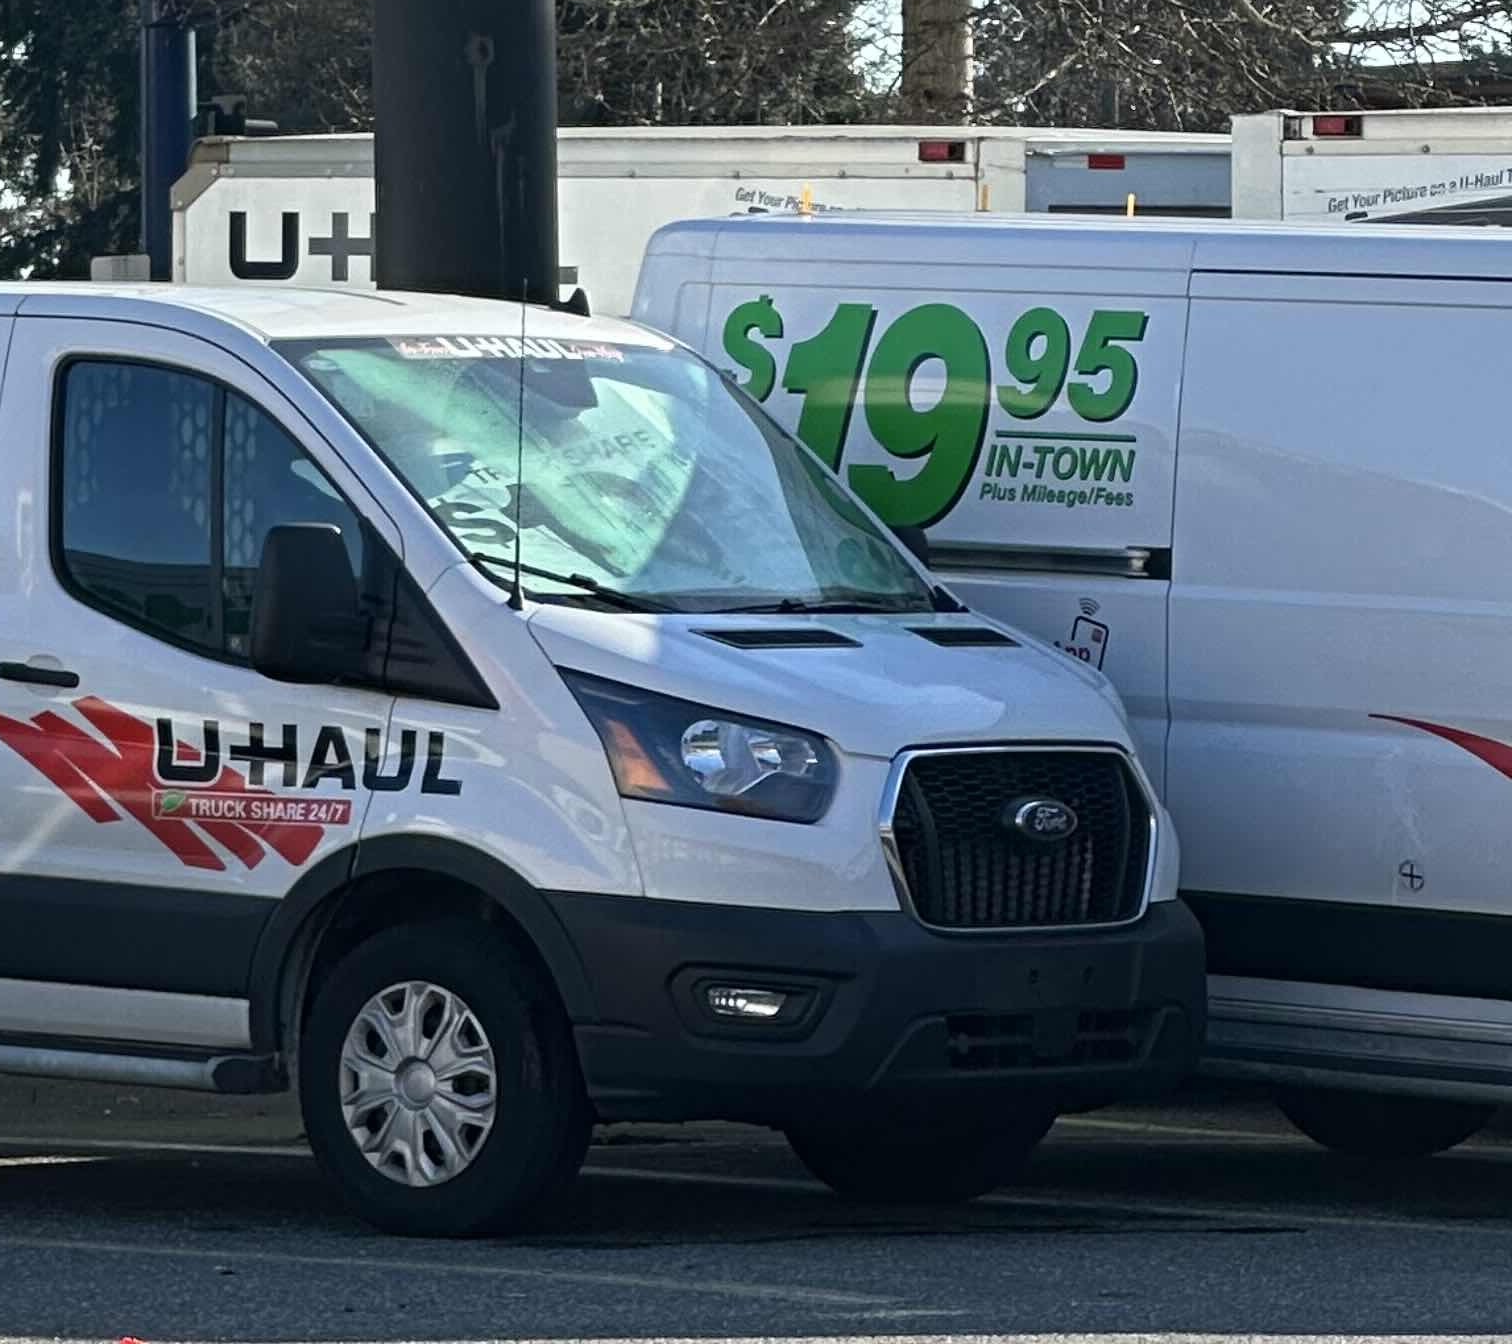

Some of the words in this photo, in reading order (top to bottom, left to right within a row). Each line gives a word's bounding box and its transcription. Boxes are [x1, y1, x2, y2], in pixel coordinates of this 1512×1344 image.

[735, 187, 755, 203] Get
[1328, 196, 1349, 212] Get
[1352, 193, 1380, 208] Your
[1383, 185, 1427, 204] Picture
[436, 337, 584, 359] U-HAUL
[984, 444, 1136, 482] IN-TOWN
[979, 481, 1016, 501] Plus
[1021, 483, 1134, 507] Mileage/Fees
[156, 717, 463, 797] U-HAUL
[189, 798, 247, 818] TRUCK
[250, 800, 305, 821] SHARE
[309, 803, 344, 822] 24/7
